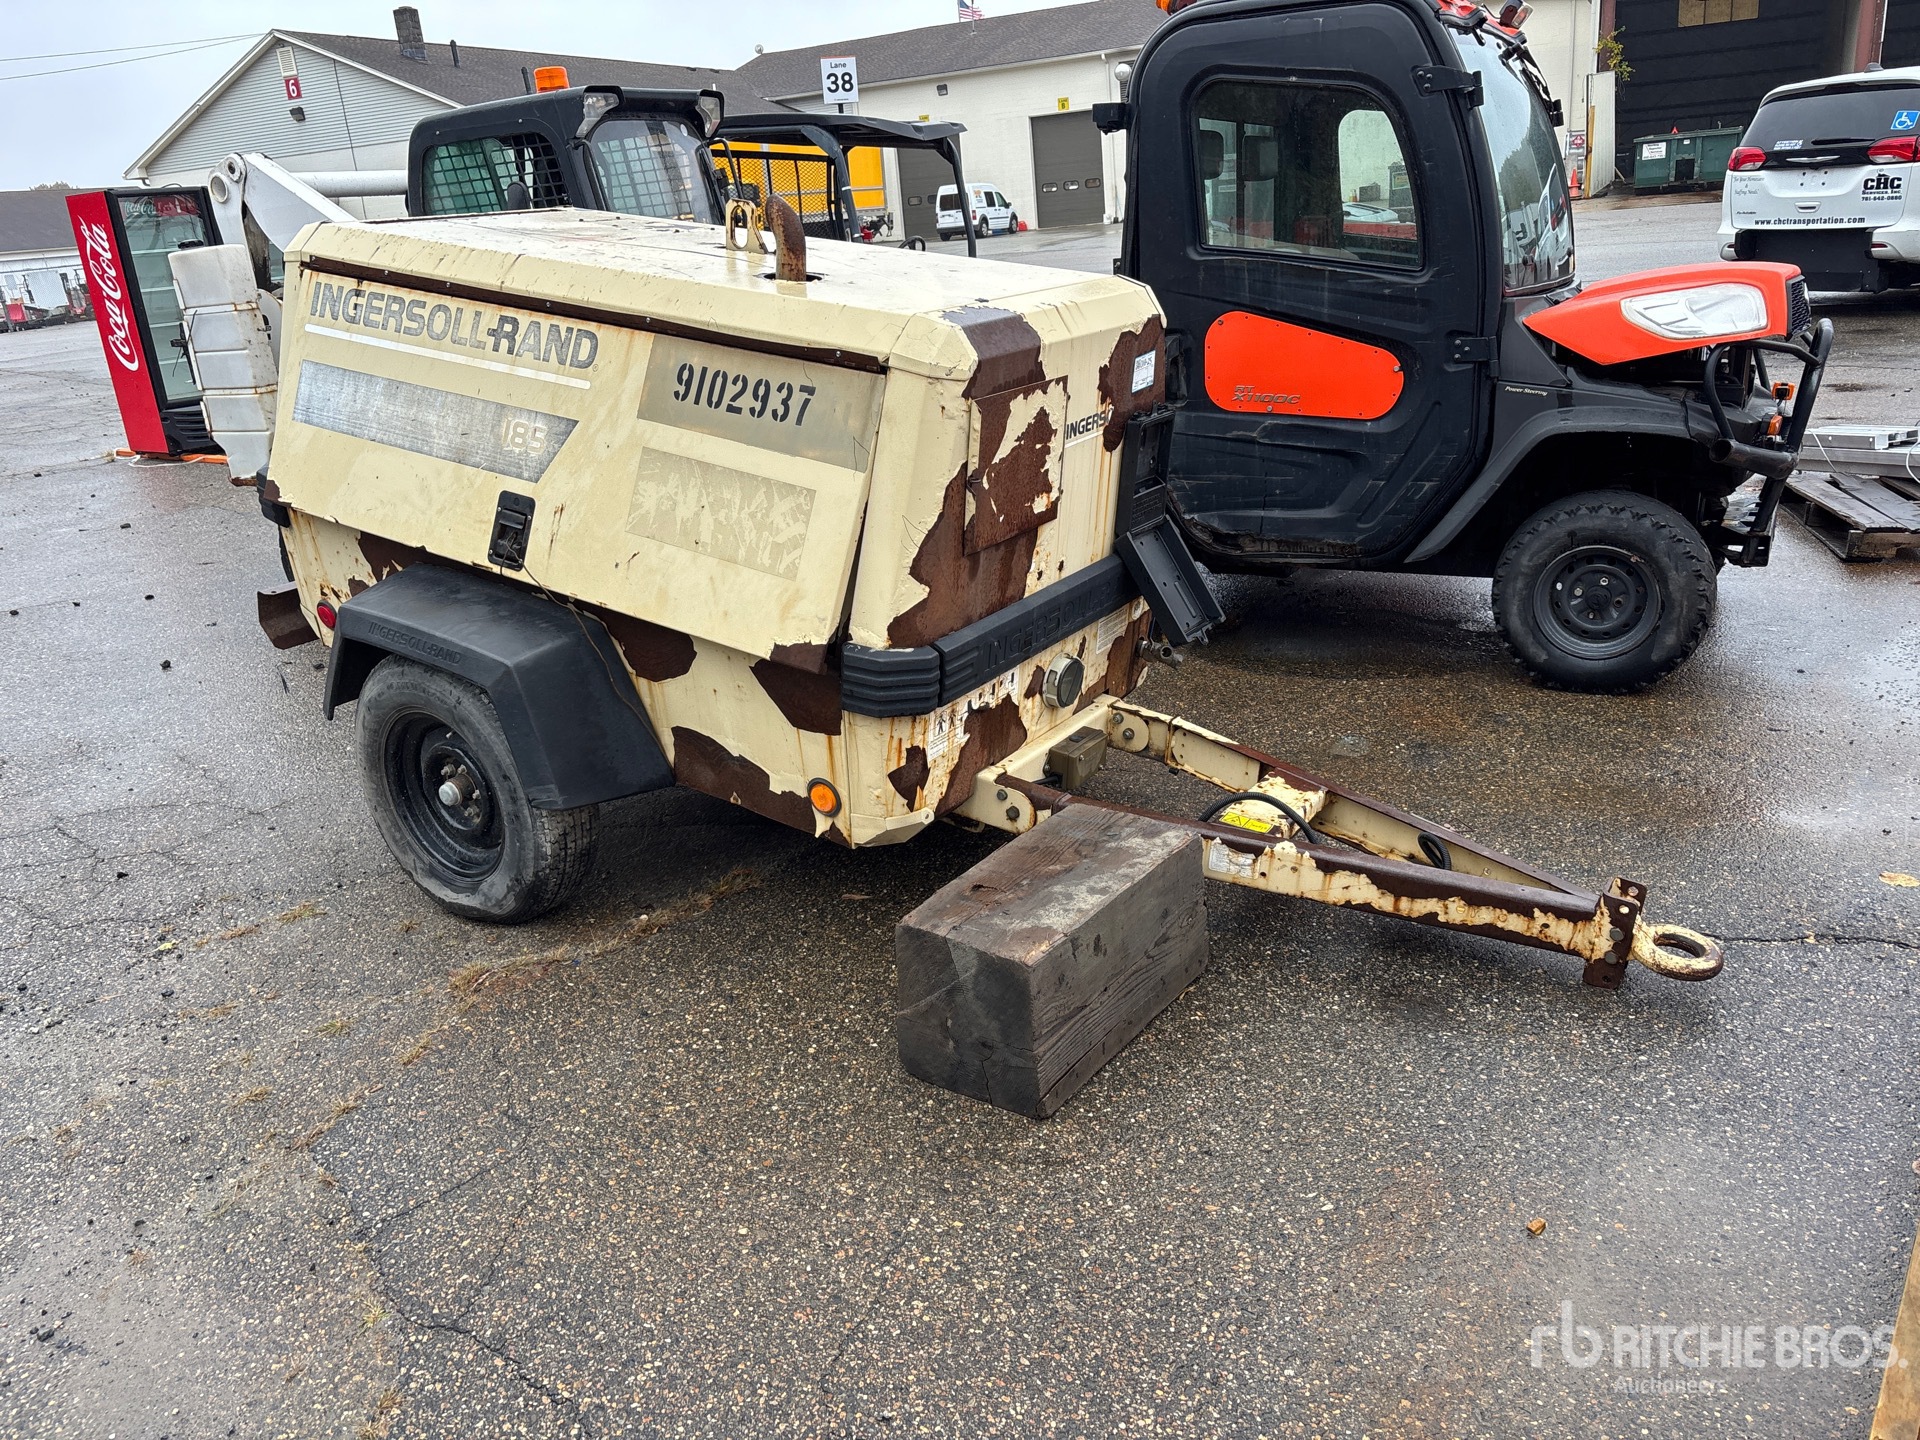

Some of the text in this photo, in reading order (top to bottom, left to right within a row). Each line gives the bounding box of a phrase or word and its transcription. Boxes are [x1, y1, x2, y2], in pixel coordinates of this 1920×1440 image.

[288, 79, 298, 97] 6
[826, 71, 854, 93] 38
[1863, 176, 1902, 190] CHC
[1754, 216, 1866, 226] www.chctransportation.com
[77, 214, 139, 372] Coca-Cola
[309, 281, 599, 370] INGERSOLL-RAND
[673, 362, 817, 427] 9102937
[1231, 392, 1301, 405] X1100C
[1234, 384, 1255, 393] RT
[1523, 387, 1549, 397] Steering
[500, 413, 549, 455] 185
[367, 620, 462, 665] INGERSOLL-RAND
